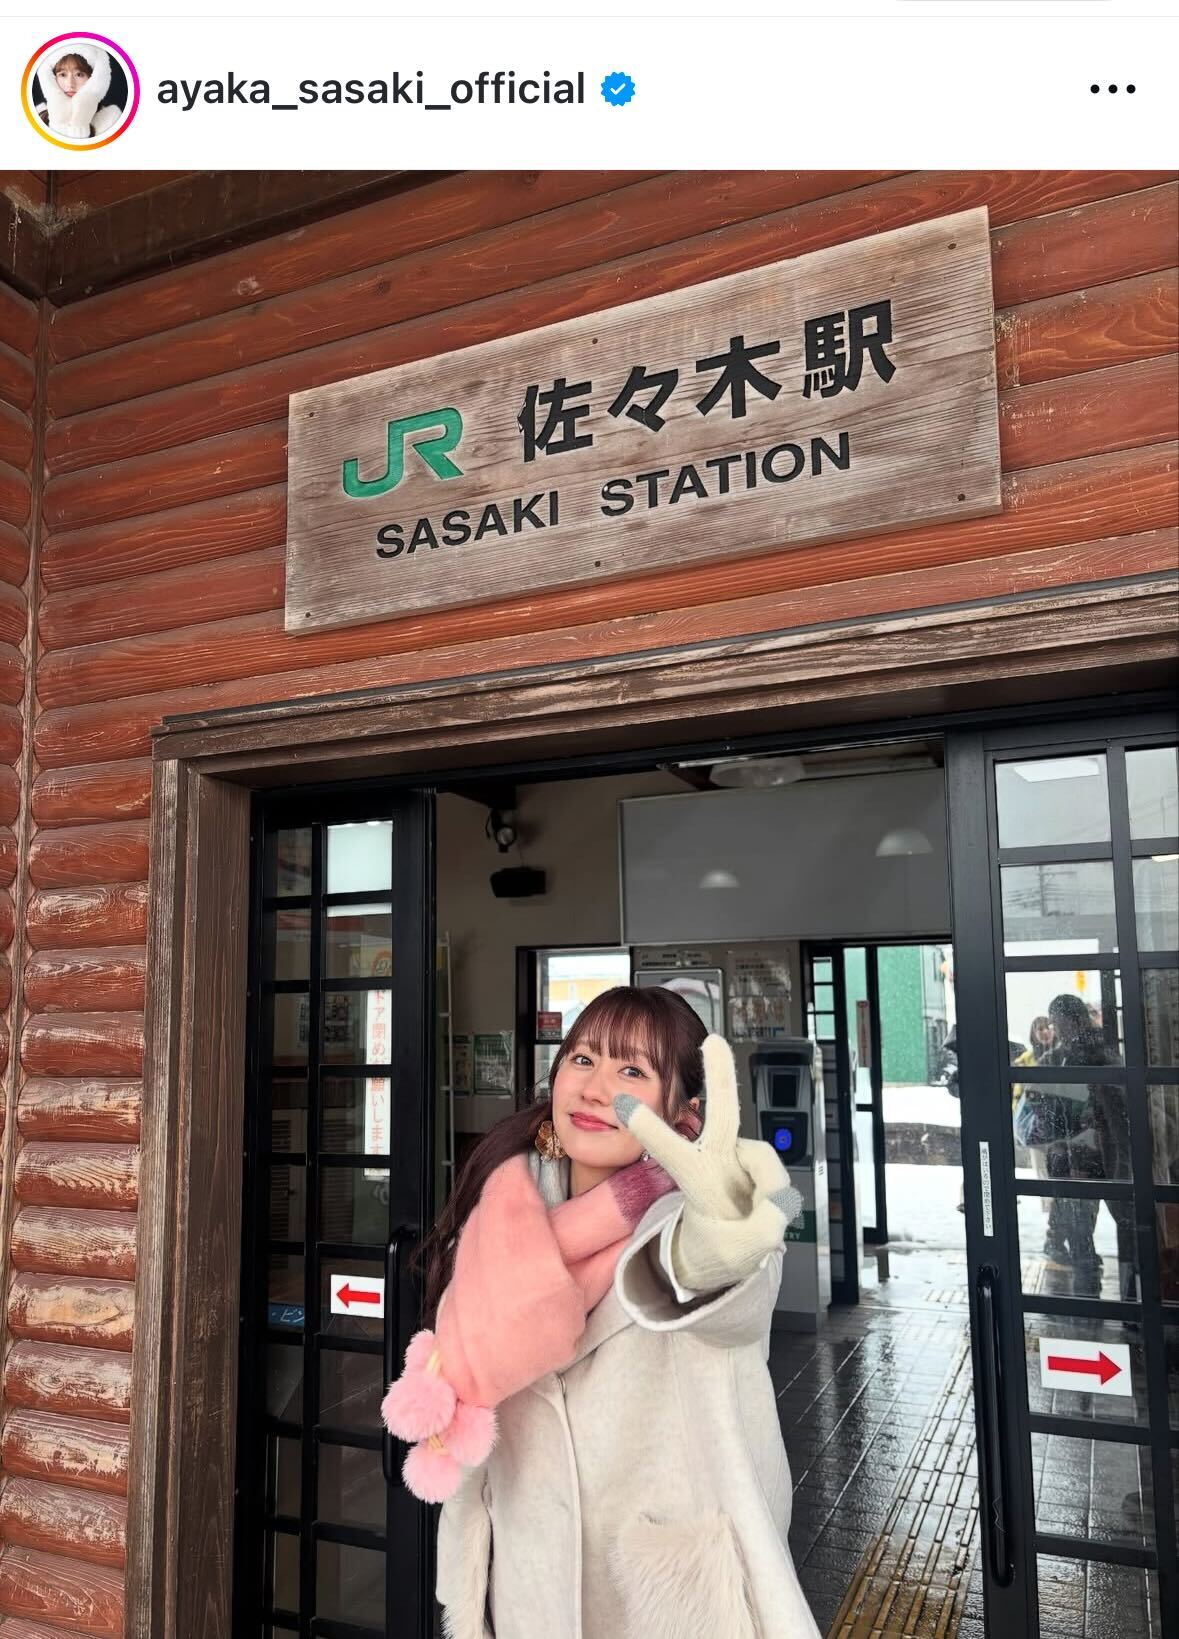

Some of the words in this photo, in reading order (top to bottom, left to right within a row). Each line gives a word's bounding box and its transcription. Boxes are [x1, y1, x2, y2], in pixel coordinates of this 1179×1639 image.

[343, 407, 463, 498] JR
[517, 299, 897, 463] 佐々木駅
[376, 490, 559, 559] SASAKI
[600, 431, 850, 517] STATION
